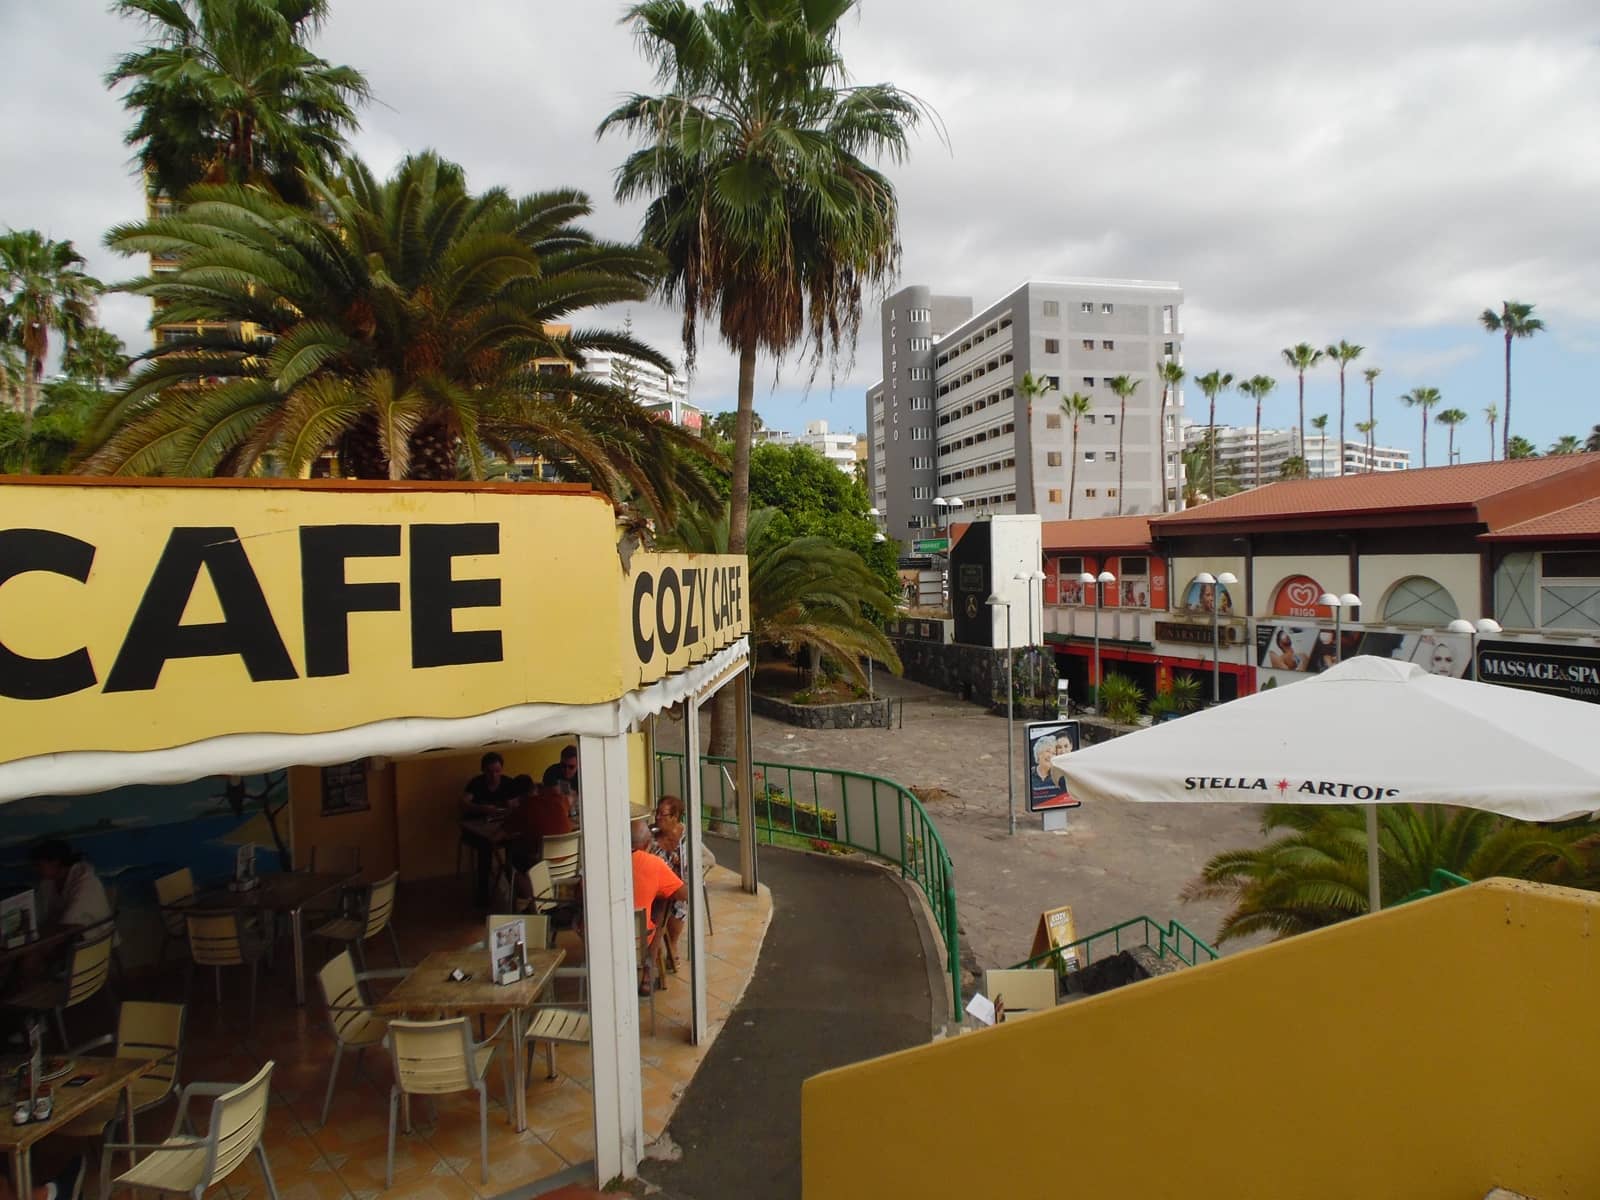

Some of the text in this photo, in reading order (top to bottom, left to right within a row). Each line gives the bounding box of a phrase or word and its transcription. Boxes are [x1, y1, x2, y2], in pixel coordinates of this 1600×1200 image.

[890, 309, 899, 441] ACAPULCO
[0, 523, 503, 700] CAFE
[632, 566, 741, 664] COZY CAFE
[1290, 607, 1316, 617] FRIGO
[1184, 777, 1268, 790] STELLA
